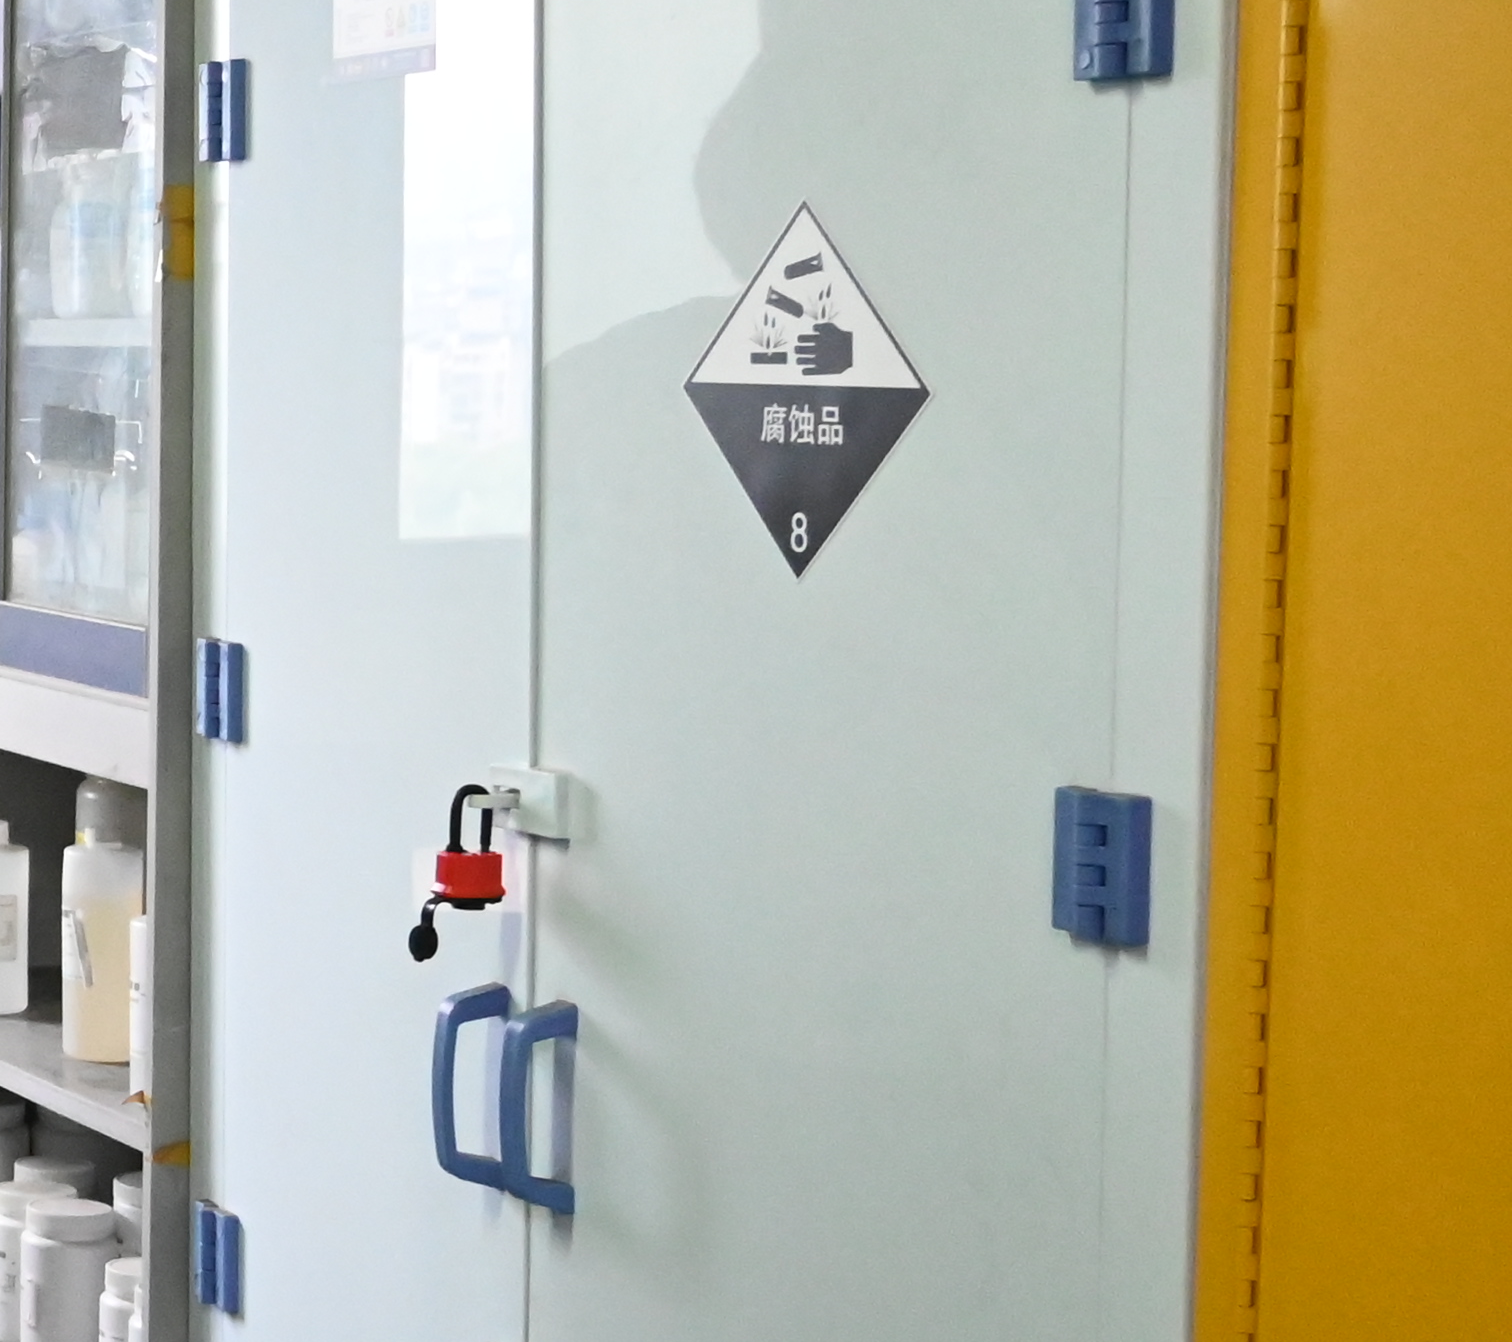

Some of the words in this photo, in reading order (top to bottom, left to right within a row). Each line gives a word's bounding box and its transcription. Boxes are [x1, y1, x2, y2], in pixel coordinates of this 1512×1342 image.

[760, 402, 844, 445] 腐蚀品
[789, 511, 809, 553] 8
